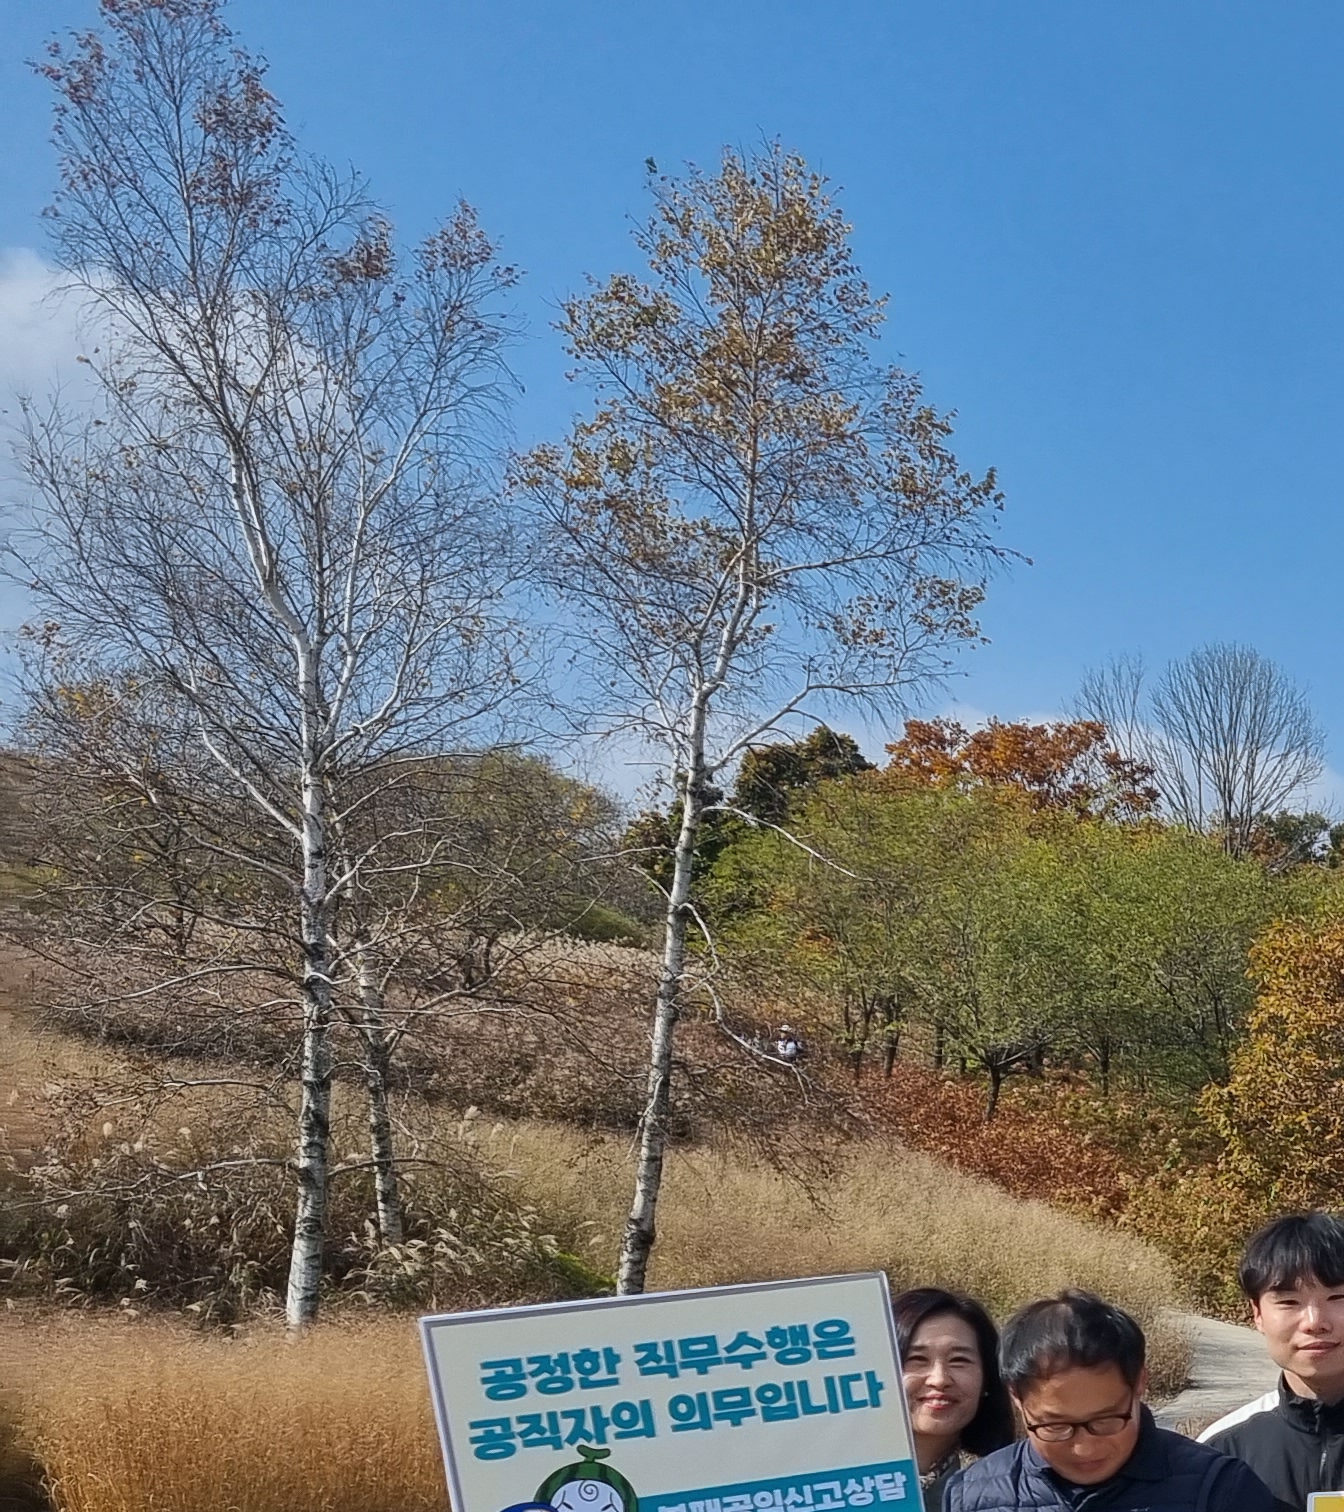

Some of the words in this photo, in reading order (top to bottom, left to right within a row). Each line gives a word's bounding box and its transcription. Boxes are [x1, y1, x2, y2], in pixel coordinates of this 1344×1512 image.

[480, 1346, 621, 1402] 공정한
[634, 1318, 856, 1380] 직무수행은
[470, 1400, 656, 1460] 공직자의
[669, 1371, 883, 1431] 의무입니다
